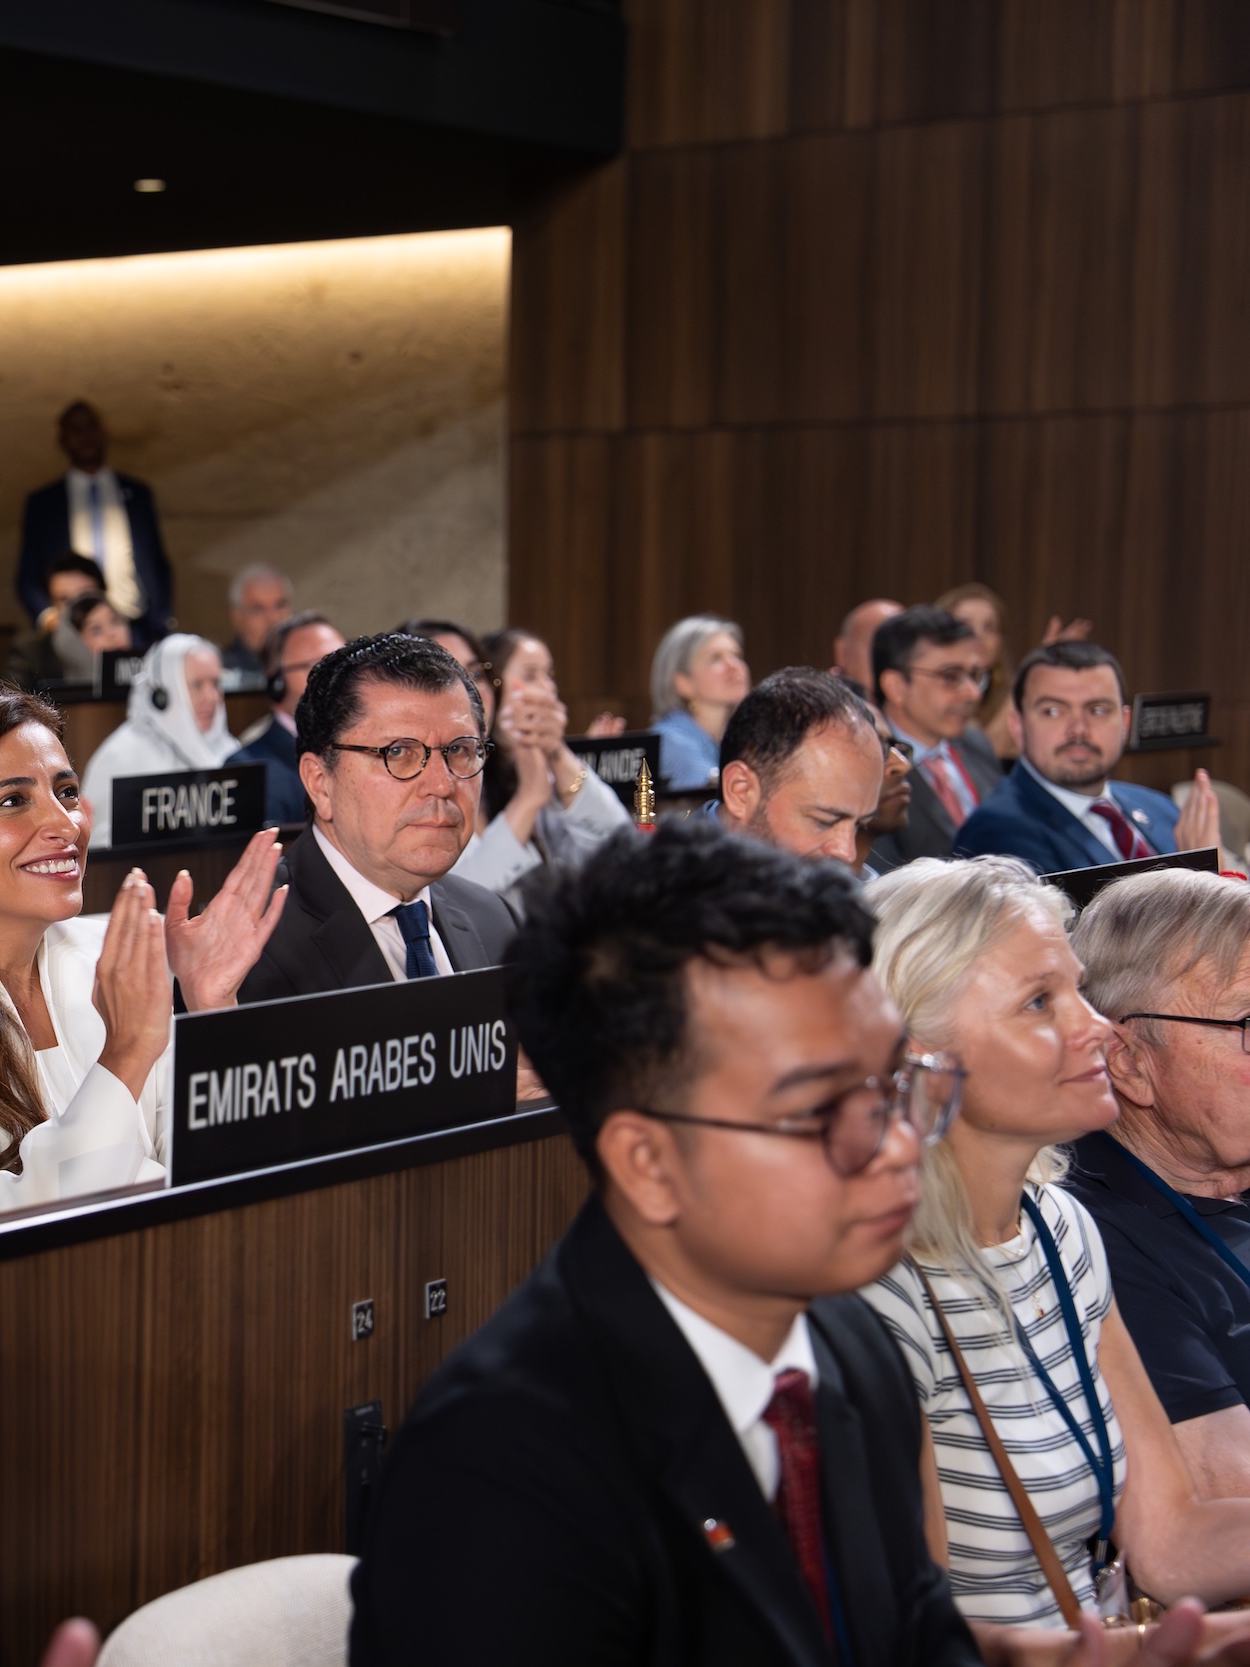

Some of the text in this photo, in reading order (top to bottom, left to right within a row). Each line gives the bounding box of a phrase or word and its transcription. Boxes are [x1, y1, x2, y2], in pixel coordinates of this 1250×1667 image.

[142, 779, 238, 833] FRANCE
[188, 1019, 506, 1131] EMIRATS ARABES UNIS
[429, 1288, 447, 1312] 22
[356, 1308, 373, 1334] 24
